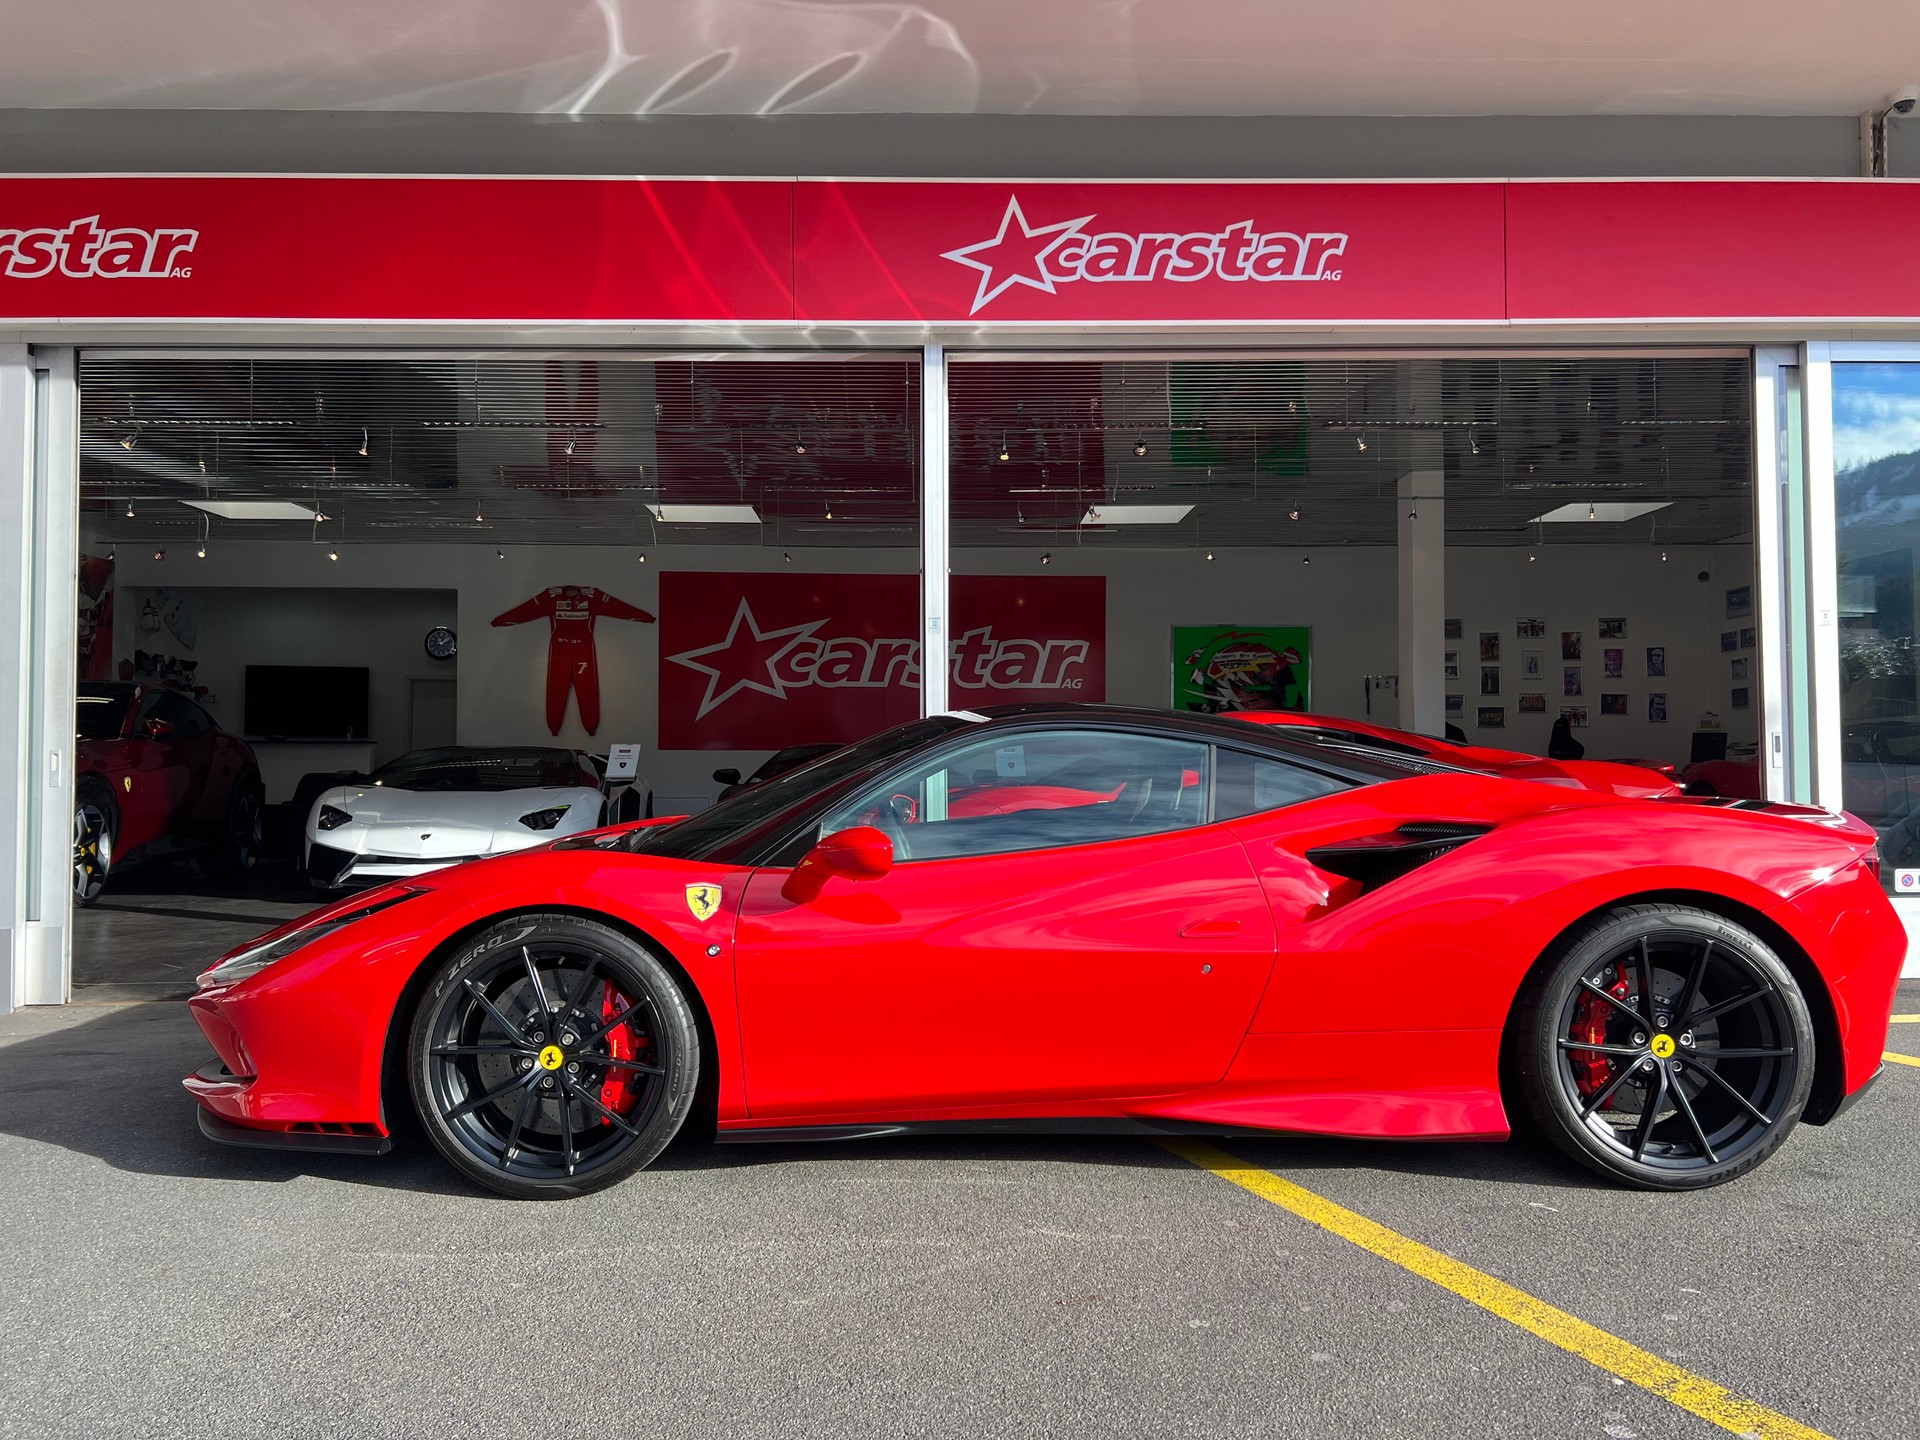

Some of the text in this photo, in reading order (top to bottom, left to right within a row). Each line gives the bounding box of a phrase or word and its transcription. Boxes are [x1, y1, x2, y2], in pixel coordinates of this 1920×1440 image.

[1045, 219, 1348, 283] carstar AG
[170, 267, 192, 278] AG
[577, 662, 588, 674] 7
[1061, 678, 1083, 689] AG
[1717, 925, 1753, 950] PIRELLI
[435, 934, 503, 998] P ZERO
[1707, 1133, 1780, 1182] P ZERO
